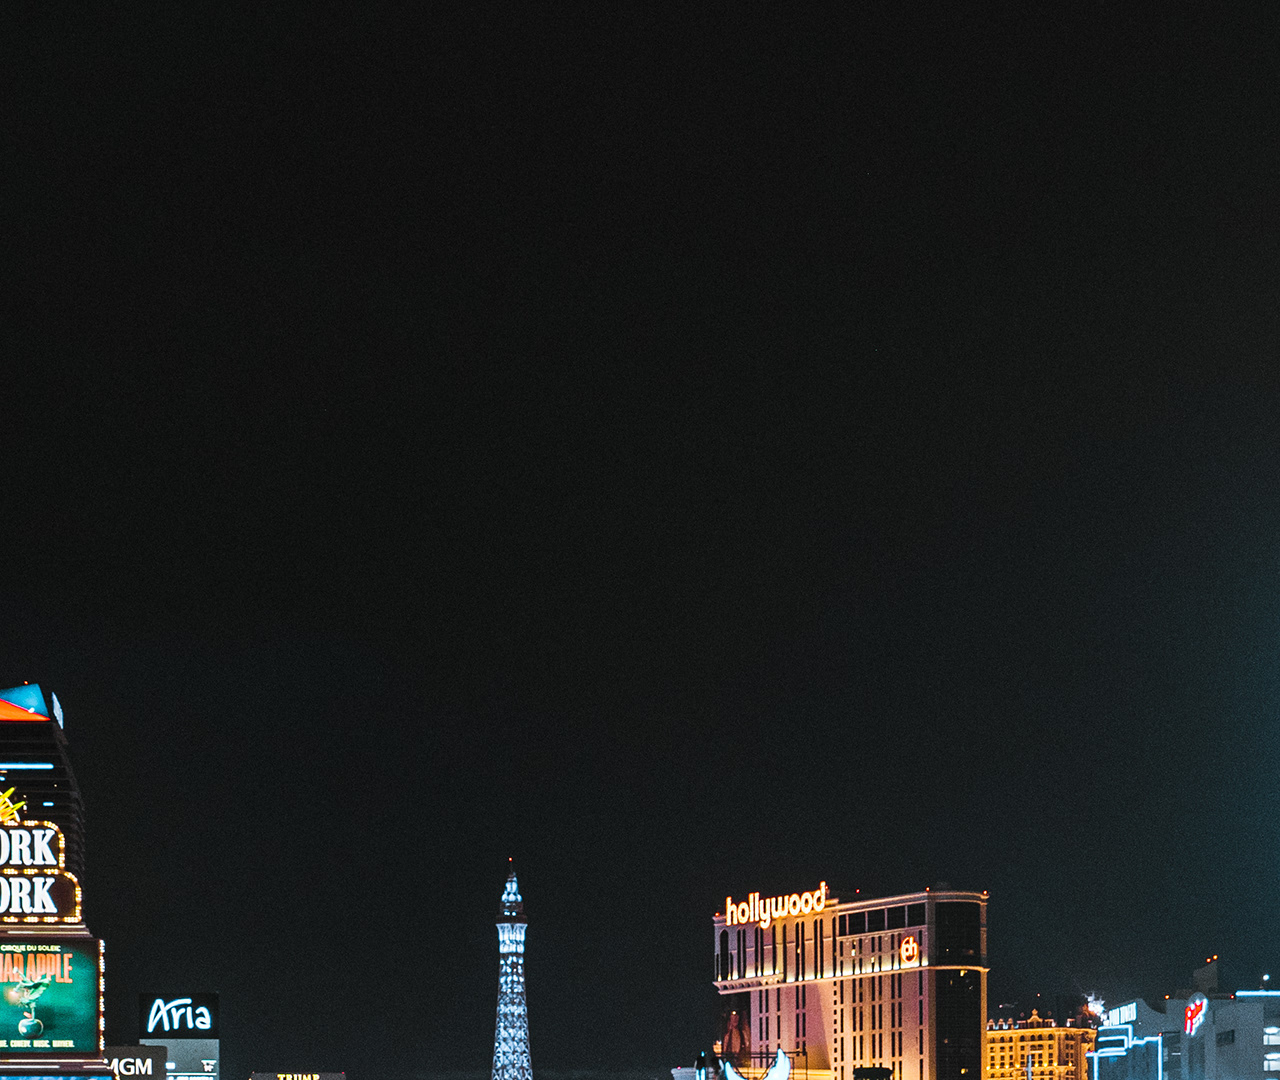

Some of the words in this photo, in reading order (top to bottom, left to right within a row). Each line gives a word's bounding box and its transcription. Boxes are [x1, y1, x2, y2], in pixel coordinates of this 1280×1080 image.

[726, 881, 827, 929] hollywood
[26, 953, 73, 984] APPLE
[147, 998, 212, 1033] Aria
